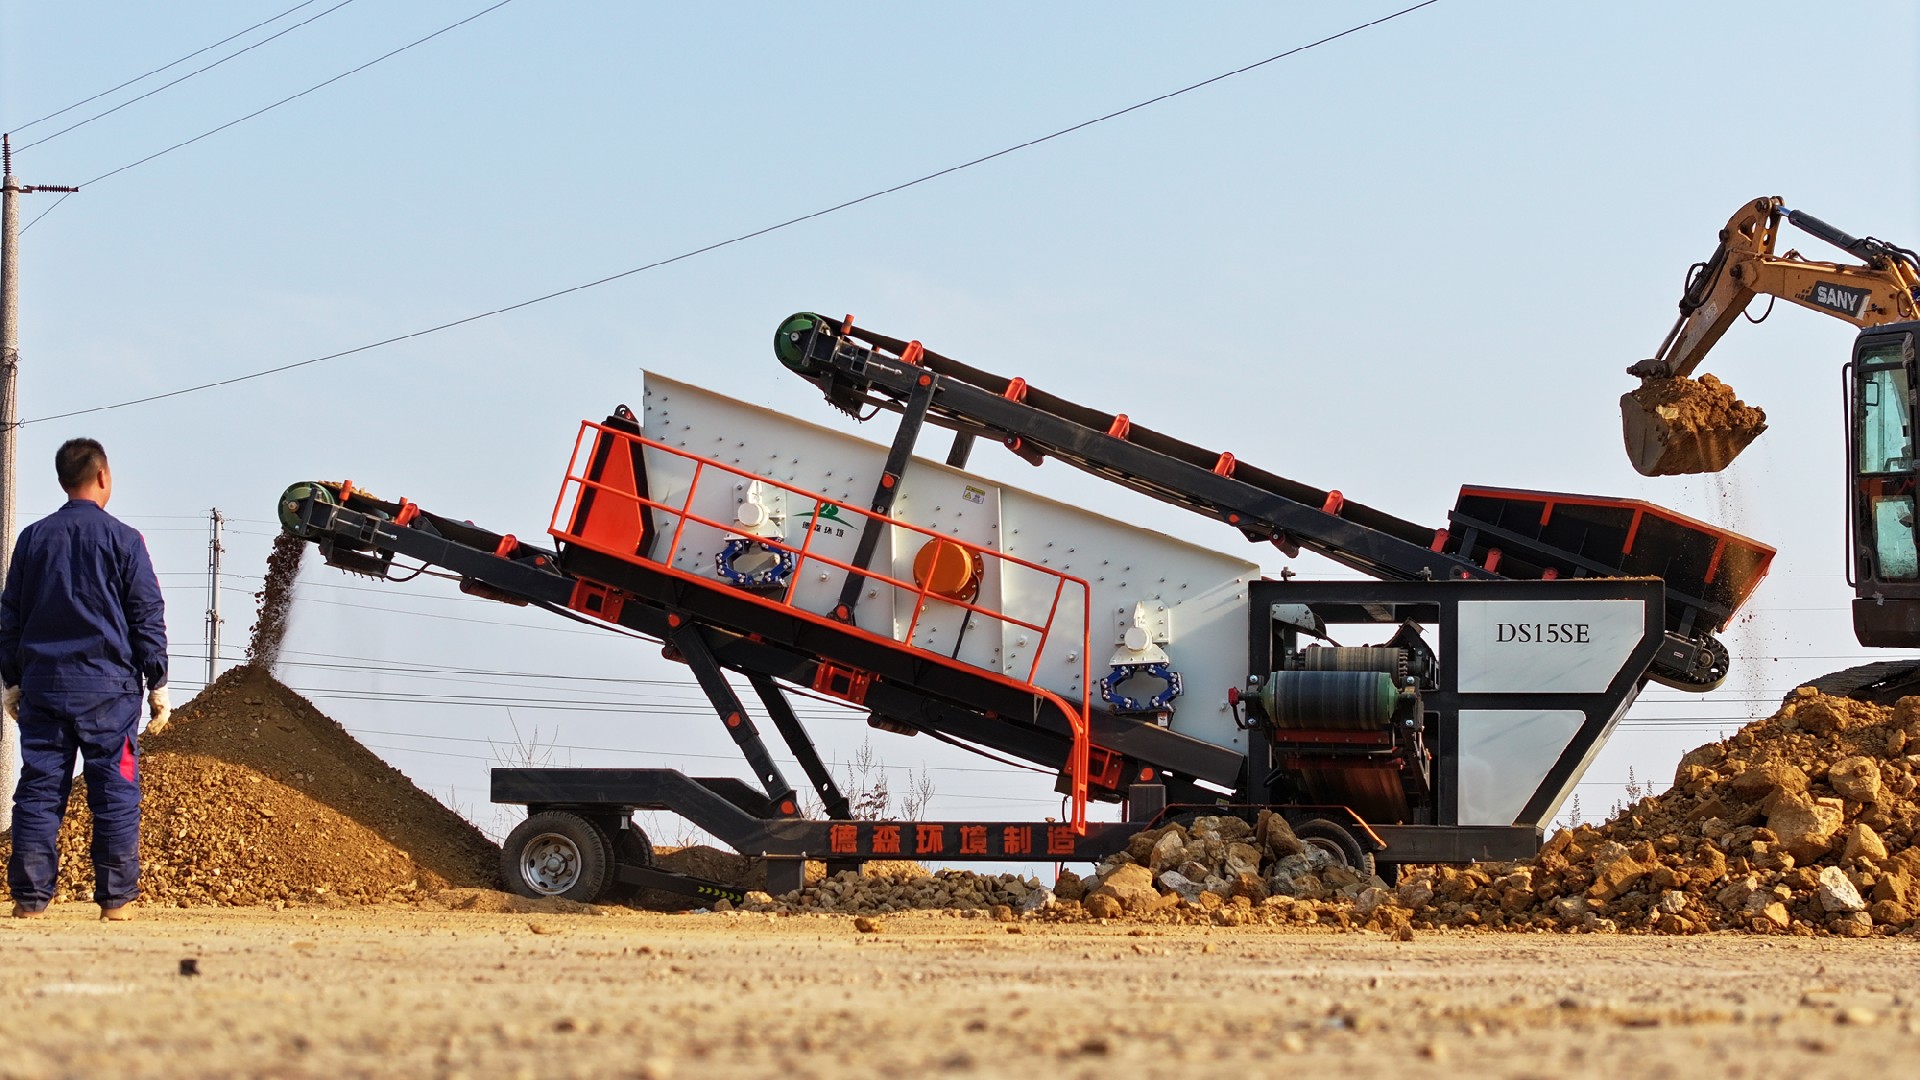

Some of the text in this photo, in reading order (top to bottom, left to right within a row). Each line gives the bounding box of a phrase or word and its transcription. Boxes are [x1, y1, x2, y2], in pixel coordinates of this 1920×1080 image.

[1817, 286, 1858, 312] SANY
[1496, 623, 1590, 643] DS15SE
[830, 824, 1075, 855] 德森环境制造
